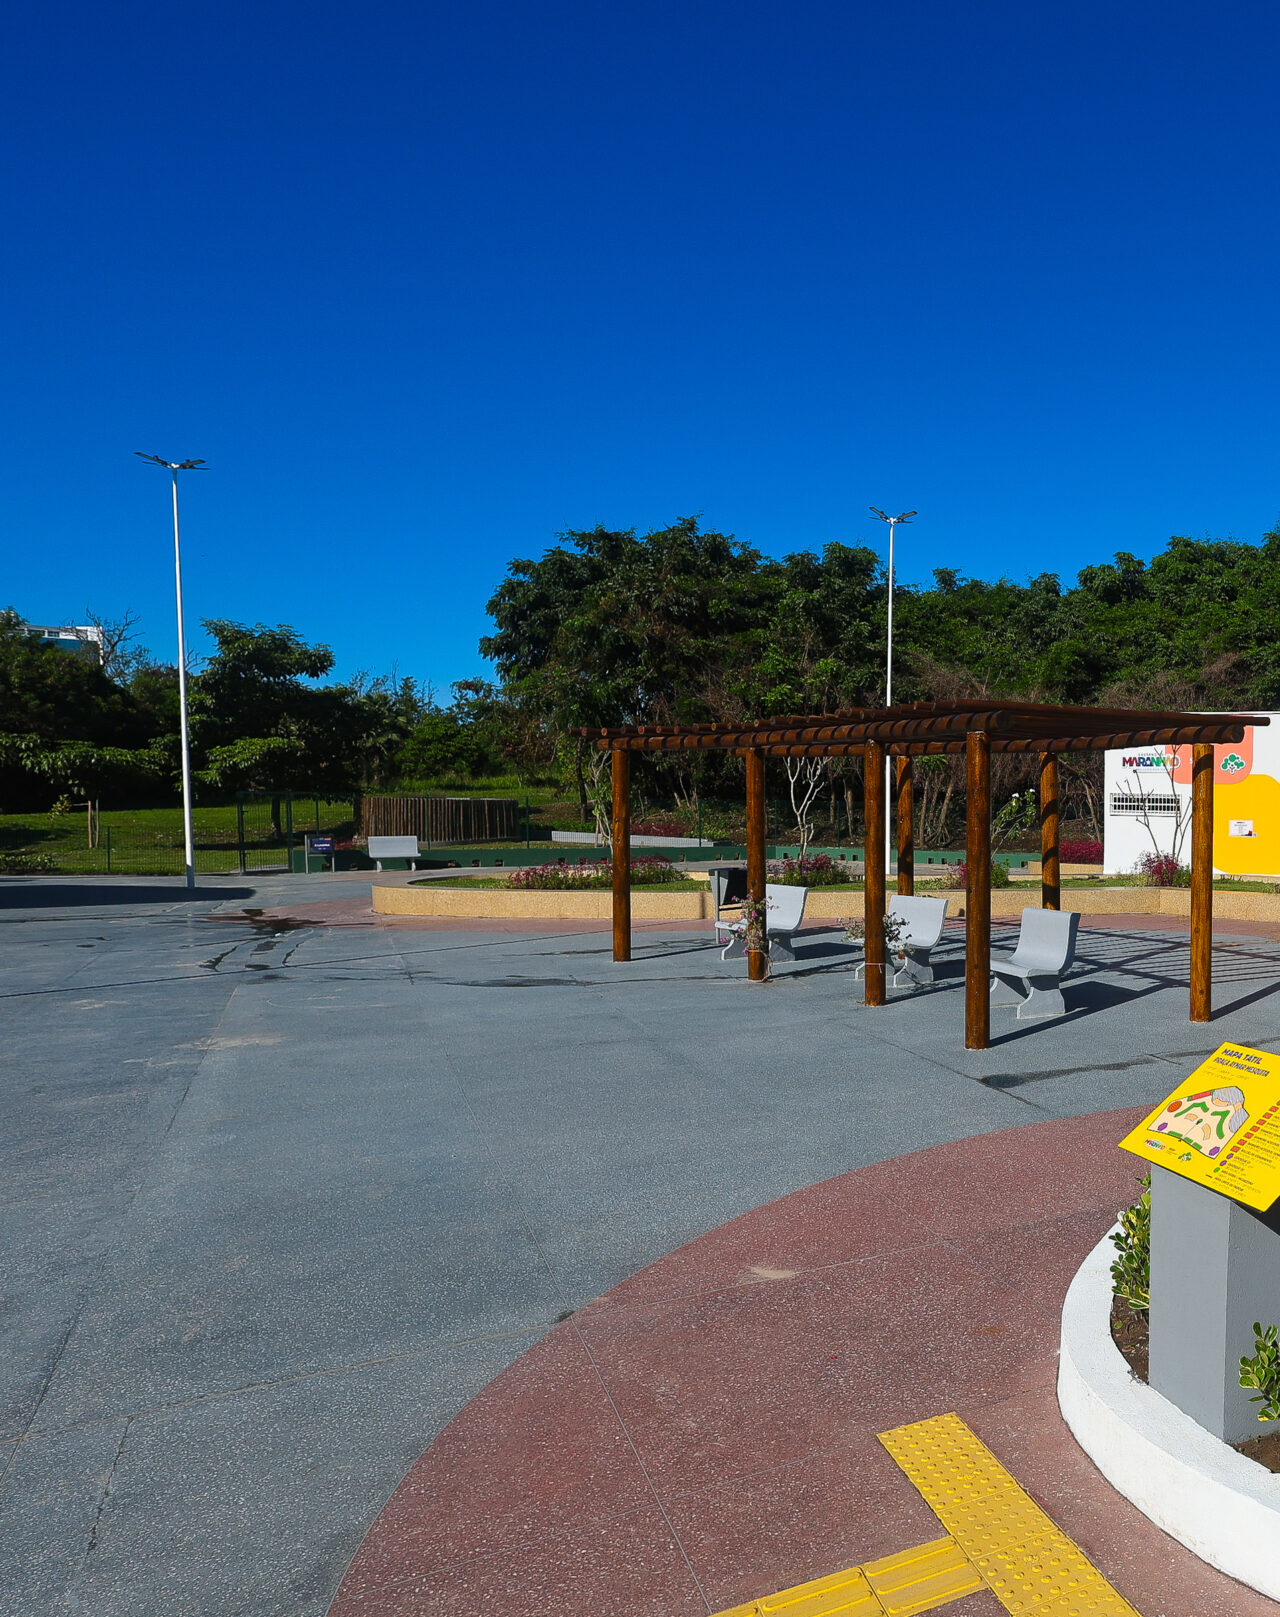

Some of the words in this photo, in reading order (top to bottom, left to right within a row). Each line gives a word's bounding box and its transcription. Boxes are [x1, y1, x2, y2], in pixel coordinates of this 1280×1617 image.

[1221, 1048, 1243, 1059] MAPA
[1243, 1053, 1263, 1065] TÁTIL
[1245, 1066, 1270, 1077] MESQUITA
